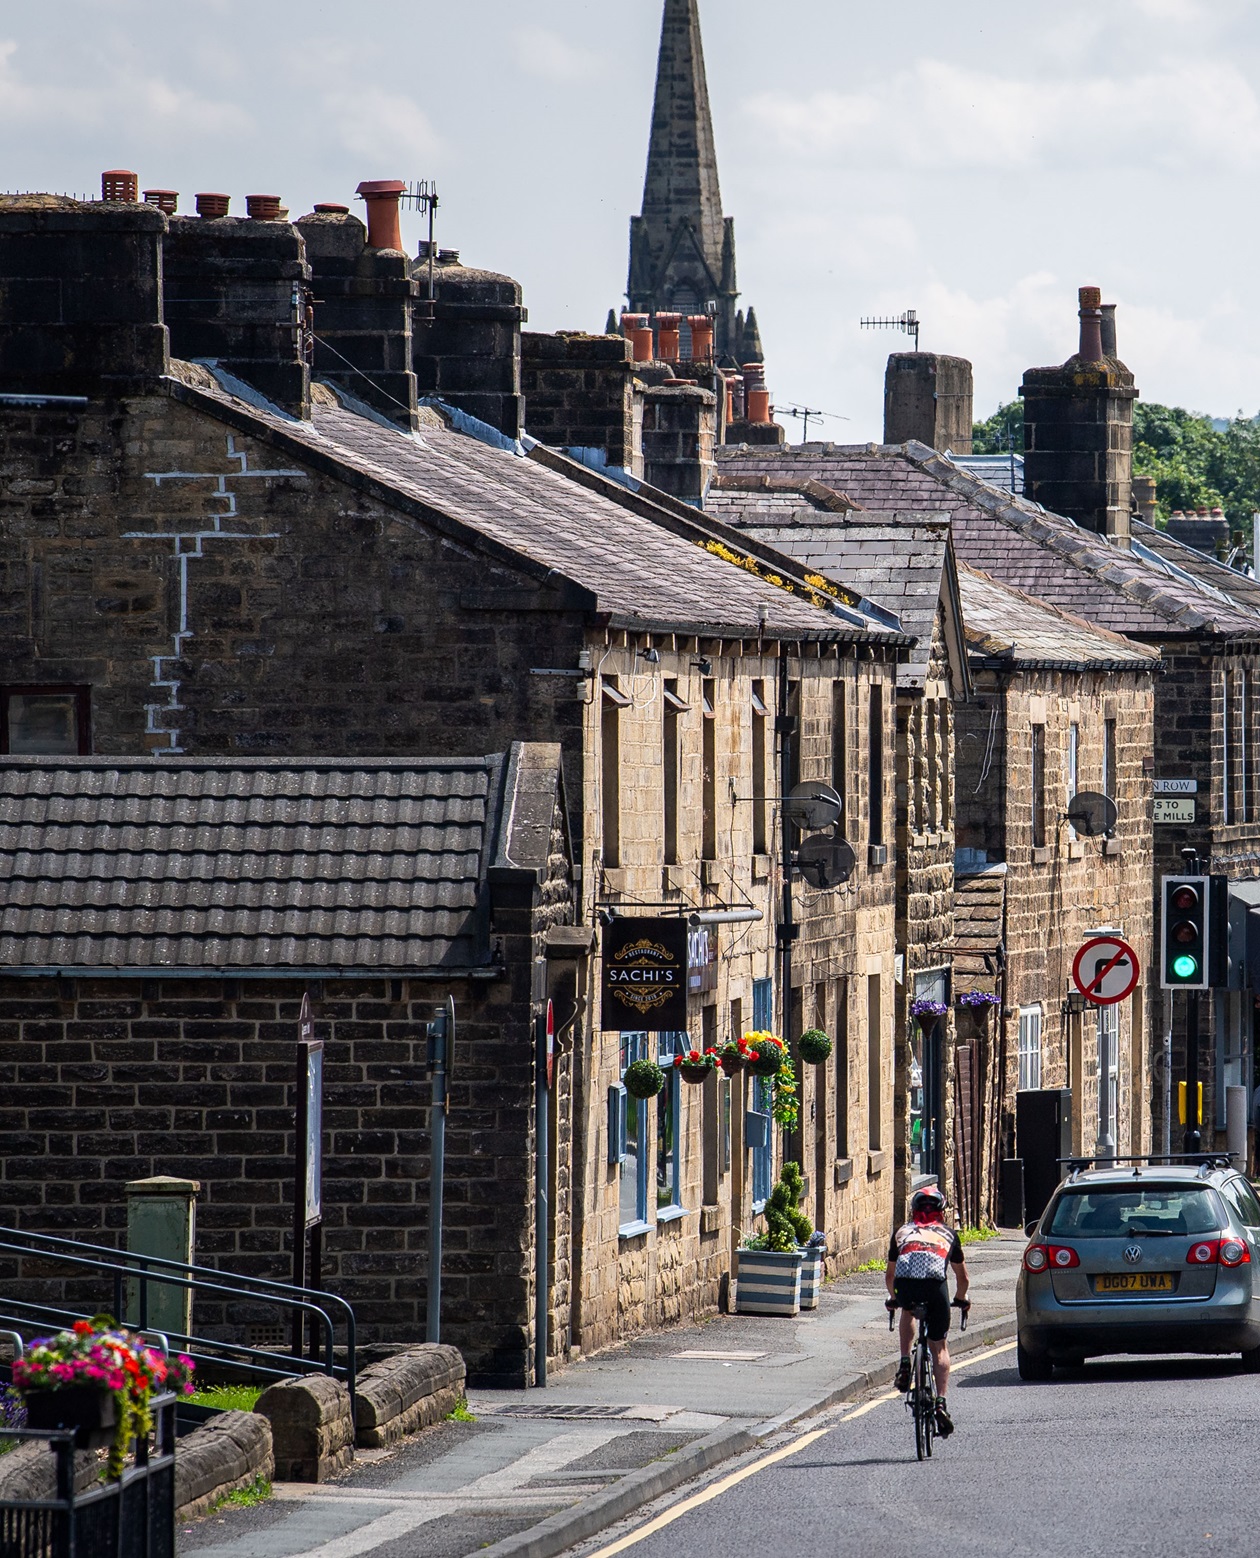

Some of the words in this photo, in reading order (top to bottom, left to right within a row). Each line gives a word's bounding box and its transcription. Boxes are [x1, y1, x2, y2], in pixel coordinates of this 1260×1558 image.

[1163, 781, 1190, 791] ROW
[1165, 801, 1179, 809] TO
[1163, 813, 1193, 821] MILLS
[628, 948, 660, 957] RESTAURANT
[609, 969, 674, 981] SACHI'S
[1103, 1276, 1137, 1289] DG07
[1140, 1275, 1167, 1288] UWA
